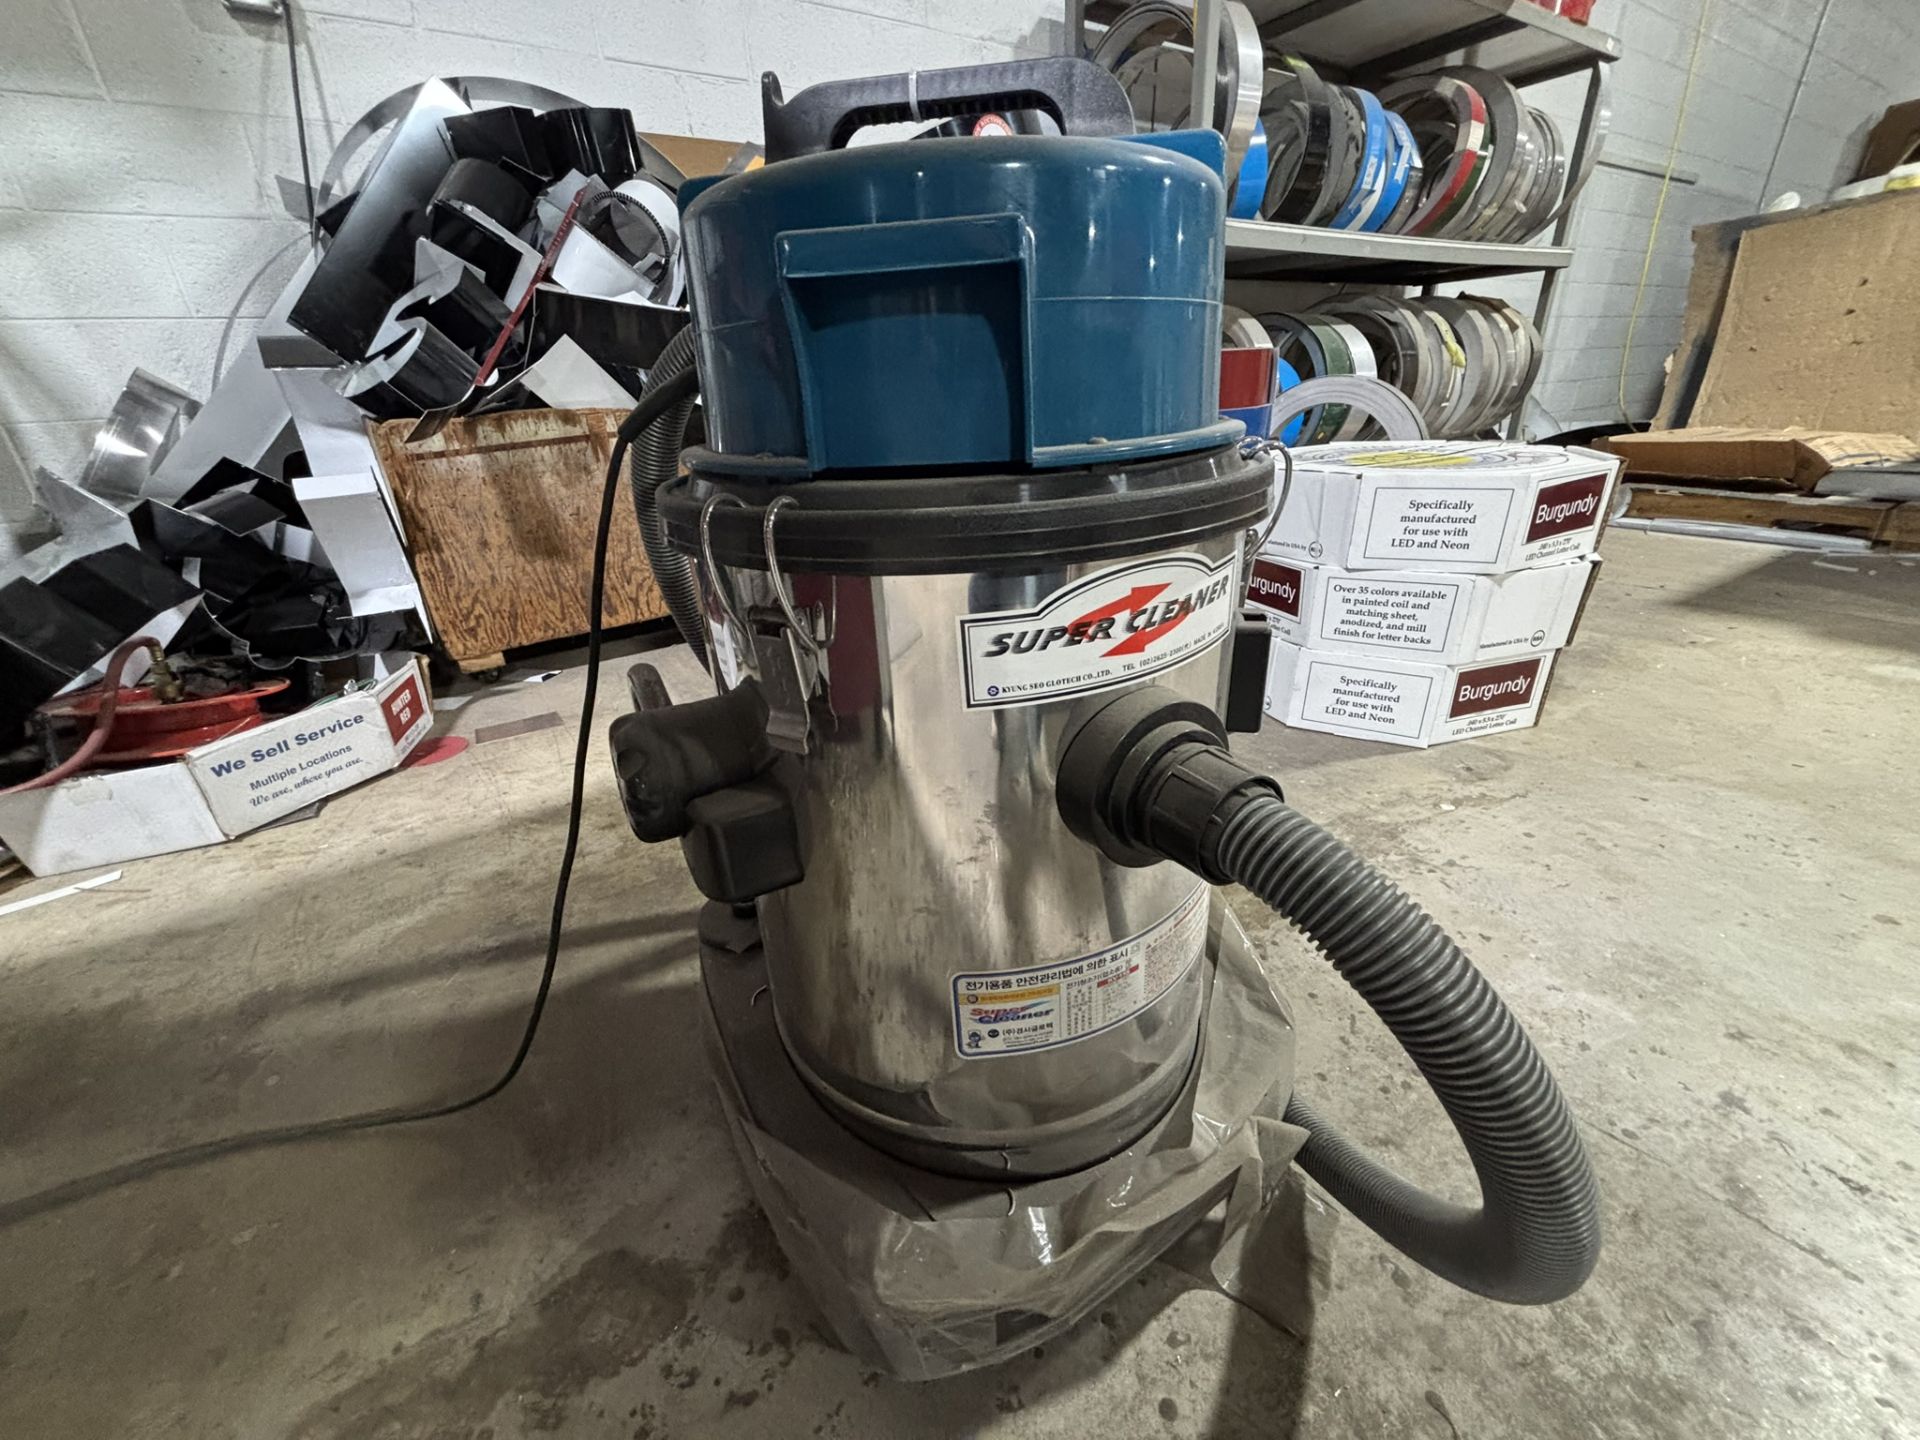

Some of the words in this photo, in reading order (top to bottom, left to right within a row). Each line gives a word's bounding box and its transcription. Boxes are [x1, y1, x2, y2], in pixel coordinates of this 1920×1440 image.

[1408, 499, 1474, 512] Specifically
[1535, 492, 1599, 524] Burgundy
[1400, 514, 1477, 524] manufactured
[1402, 526, 1420, 535] for
[1421, 528, 1441, 536] use
[1443, 527, 1468, 537] with
[1391, 538, 1415, 548] LED
[1416, 539, 1438, 549] and
[1440, 540, 1470, 550] Neon
[1249, 575, 1296, 604] urgundy
[1333, 584, 1356, 594] Over
[1358, 586, 1369, 594] 35
[1370, 587, 1399, 597] colors
[1401, 589, 1447, 600] available
[1342, 596, 1351, 604] in
[1353, 597, 1389, 608] painted
[1391, 600, 1409, 609] coil
[1411, 602, 1430, 610] and
[980, 616, 1117, 658] SUPER
[1122, 574, 1230, 633] CLEANER
[1346, 608, 1388, 620] matching
[1390, 611, 1418, 621] sheet,
[1340, 617, 1384, 630] anodized,
[1385, 622, 1404, 631] and
[1406, 624, 1427, 633] mill
[1333, 627, 1360, 638] finish
[1362, 629, 1376, 639] for
[1377, 632, 1402, 641] letter
[1403, 634, 1431, 645] backs
[1002, 683, 1028, 694] KYUNG
[1029, 681, 1044, 690] SEO
[1046, 676, 1081, 687] GLOTECH
[1122, 663, 1136, 672] TEL
[1339, 675, 1398, 693] Specifically
[1332, 687, 1401, 703] manufactured
[1458, 675, 1531, 702] Burgundy
[1335, 696, 1350, 706] for
[1352, 701, 1369, 709] use
[1370, 704, 1394, 713] with
[1324, 706, 1347, 716] LED
[1347, 711, 1366, 720] and
[1368, 713, 1396, 725] Neon
[1465, 724, 1489, 733] Channel
[1489, 721, 1504, 729] Letter
[1505, 718, 1517, 726] Coil
[210, 758, 247, 778] We
[250, 739, 290, 763] Sell
[294, 714, 365, 747] Service
[250, 766, 297, 791] Multiple
[299, 744, 352, 771] Locations
[249, 794, 270, 807] We
[272, 786, 293, 800] are,
[294, 772, 324, 790] where
[324, 763, 343, 779] you
[965, 979, 1012, 991] 전기용품
[1016, 965, 1084, 988] 안전관리법에
[1086, 957, 1107, 971] 의한
[1109, 948, 1128, 963] 표시
